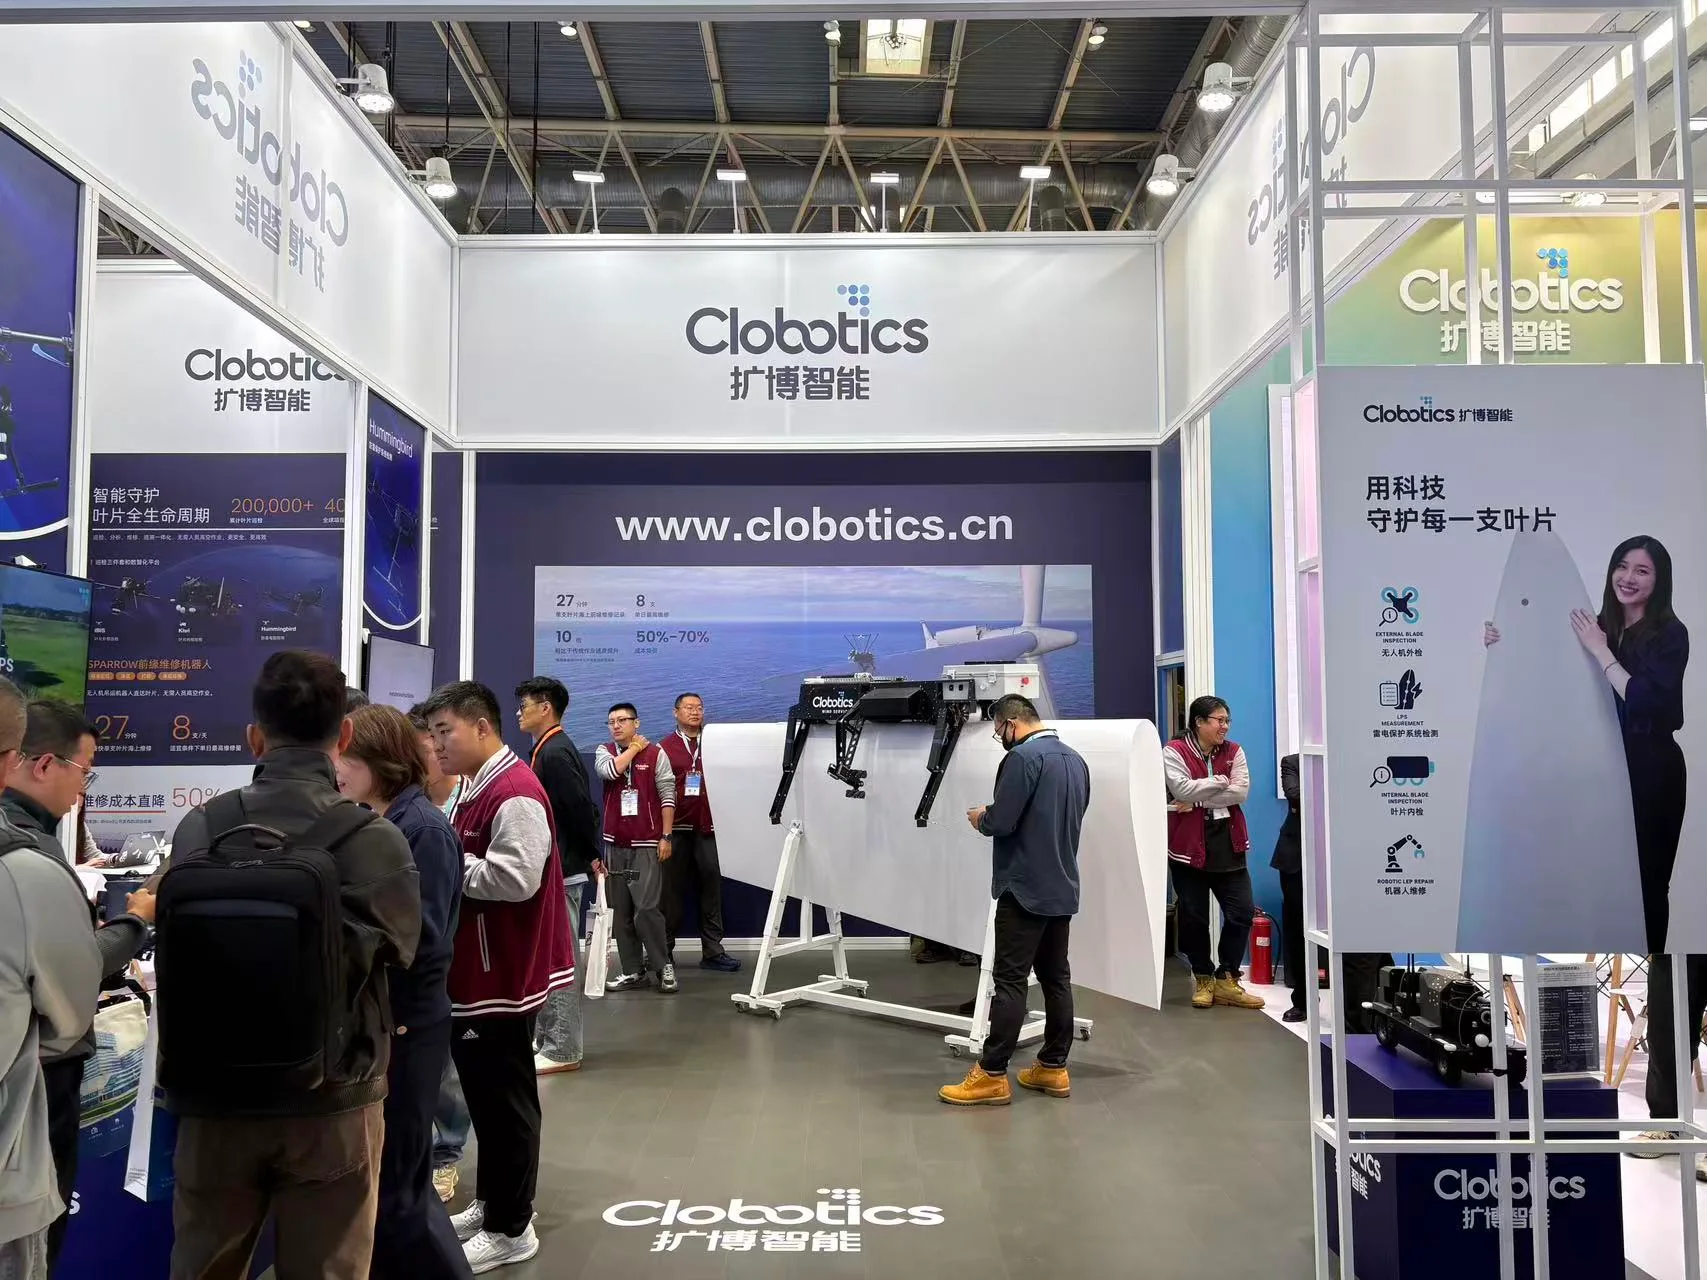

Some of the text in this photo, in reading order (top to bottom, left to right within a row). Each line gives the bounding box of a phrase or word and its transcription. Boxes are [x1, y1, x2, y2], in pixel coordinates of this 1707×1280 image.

[1399, 268, 1624, 312] Clobotics
[685, 306, 930, 355] Clobotics
[184, 348, 346, 381] Clobotic
[730, 365, 870, 401] 扩博智能
[214, 388, 311, 412] 扩博智能
[1363, 404, 1513, 423] Clobotics 扩博智能
[369, 418, 413, 458] Hummingbird
[92, 487, 160, 504] 智能守护
[1366, 474, 1446, 501] 用科技
[92, 507, 211, 525] 叶片全生命周期
[231, 497, 315, 516] 200,000+
[615, 506, 1013, 541] www.clobotics.cn
[1367, 506, 1557, 533] 守护每一支叶片
[556, 594, 588, 608] 27 分钟
[635, 594, 646, 607] 8
[556, 630, 572, 643] 10
[635, 630, 710, 643] 50%-70%
[1381, 648, 1423, 657] 无人机外检
[812, 696, 854, 709] Clobotics
[95, 715, 130, 740] 27
[172, 714, 191, 741] 8
[1372, 729, 1439, 738] 雷电保护系统检测
[1390, 808, 1424, 816] 叶片内检
[1384, 887, 1427, 895] 机器人维修
[602, 1199, 945, 1226] Clobotics
[650, 1230, 861, 1252] 扩博智能
